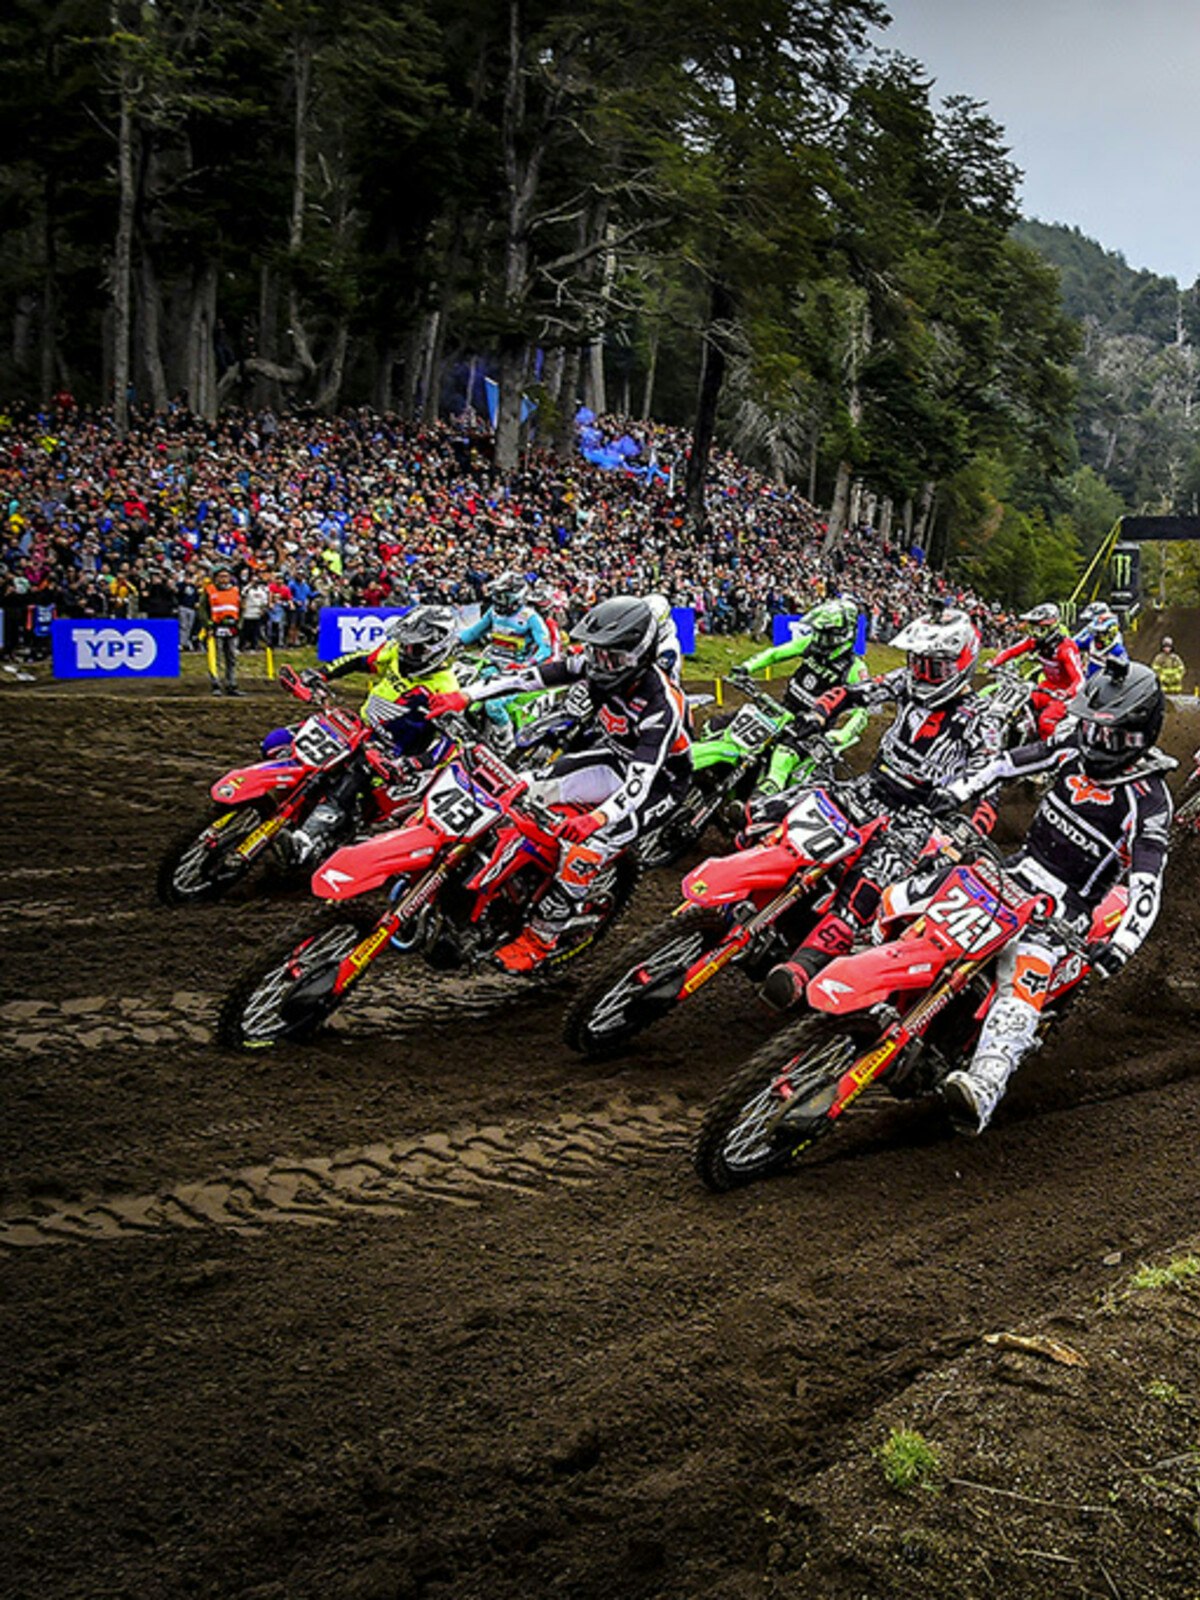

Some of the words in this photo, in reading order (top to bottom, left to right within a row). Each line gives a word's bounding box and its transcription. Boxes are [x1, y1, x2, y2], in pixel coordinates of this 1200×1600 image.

[86, 640, 144, 658] YPF
[351, 626, 392, 641] YP
[431, 787, 484, 834] 43
[788, 810, 845, 857] 70
[926, 885, 1003, 954] 243
[1125, 878, 1157, 936] FOX
